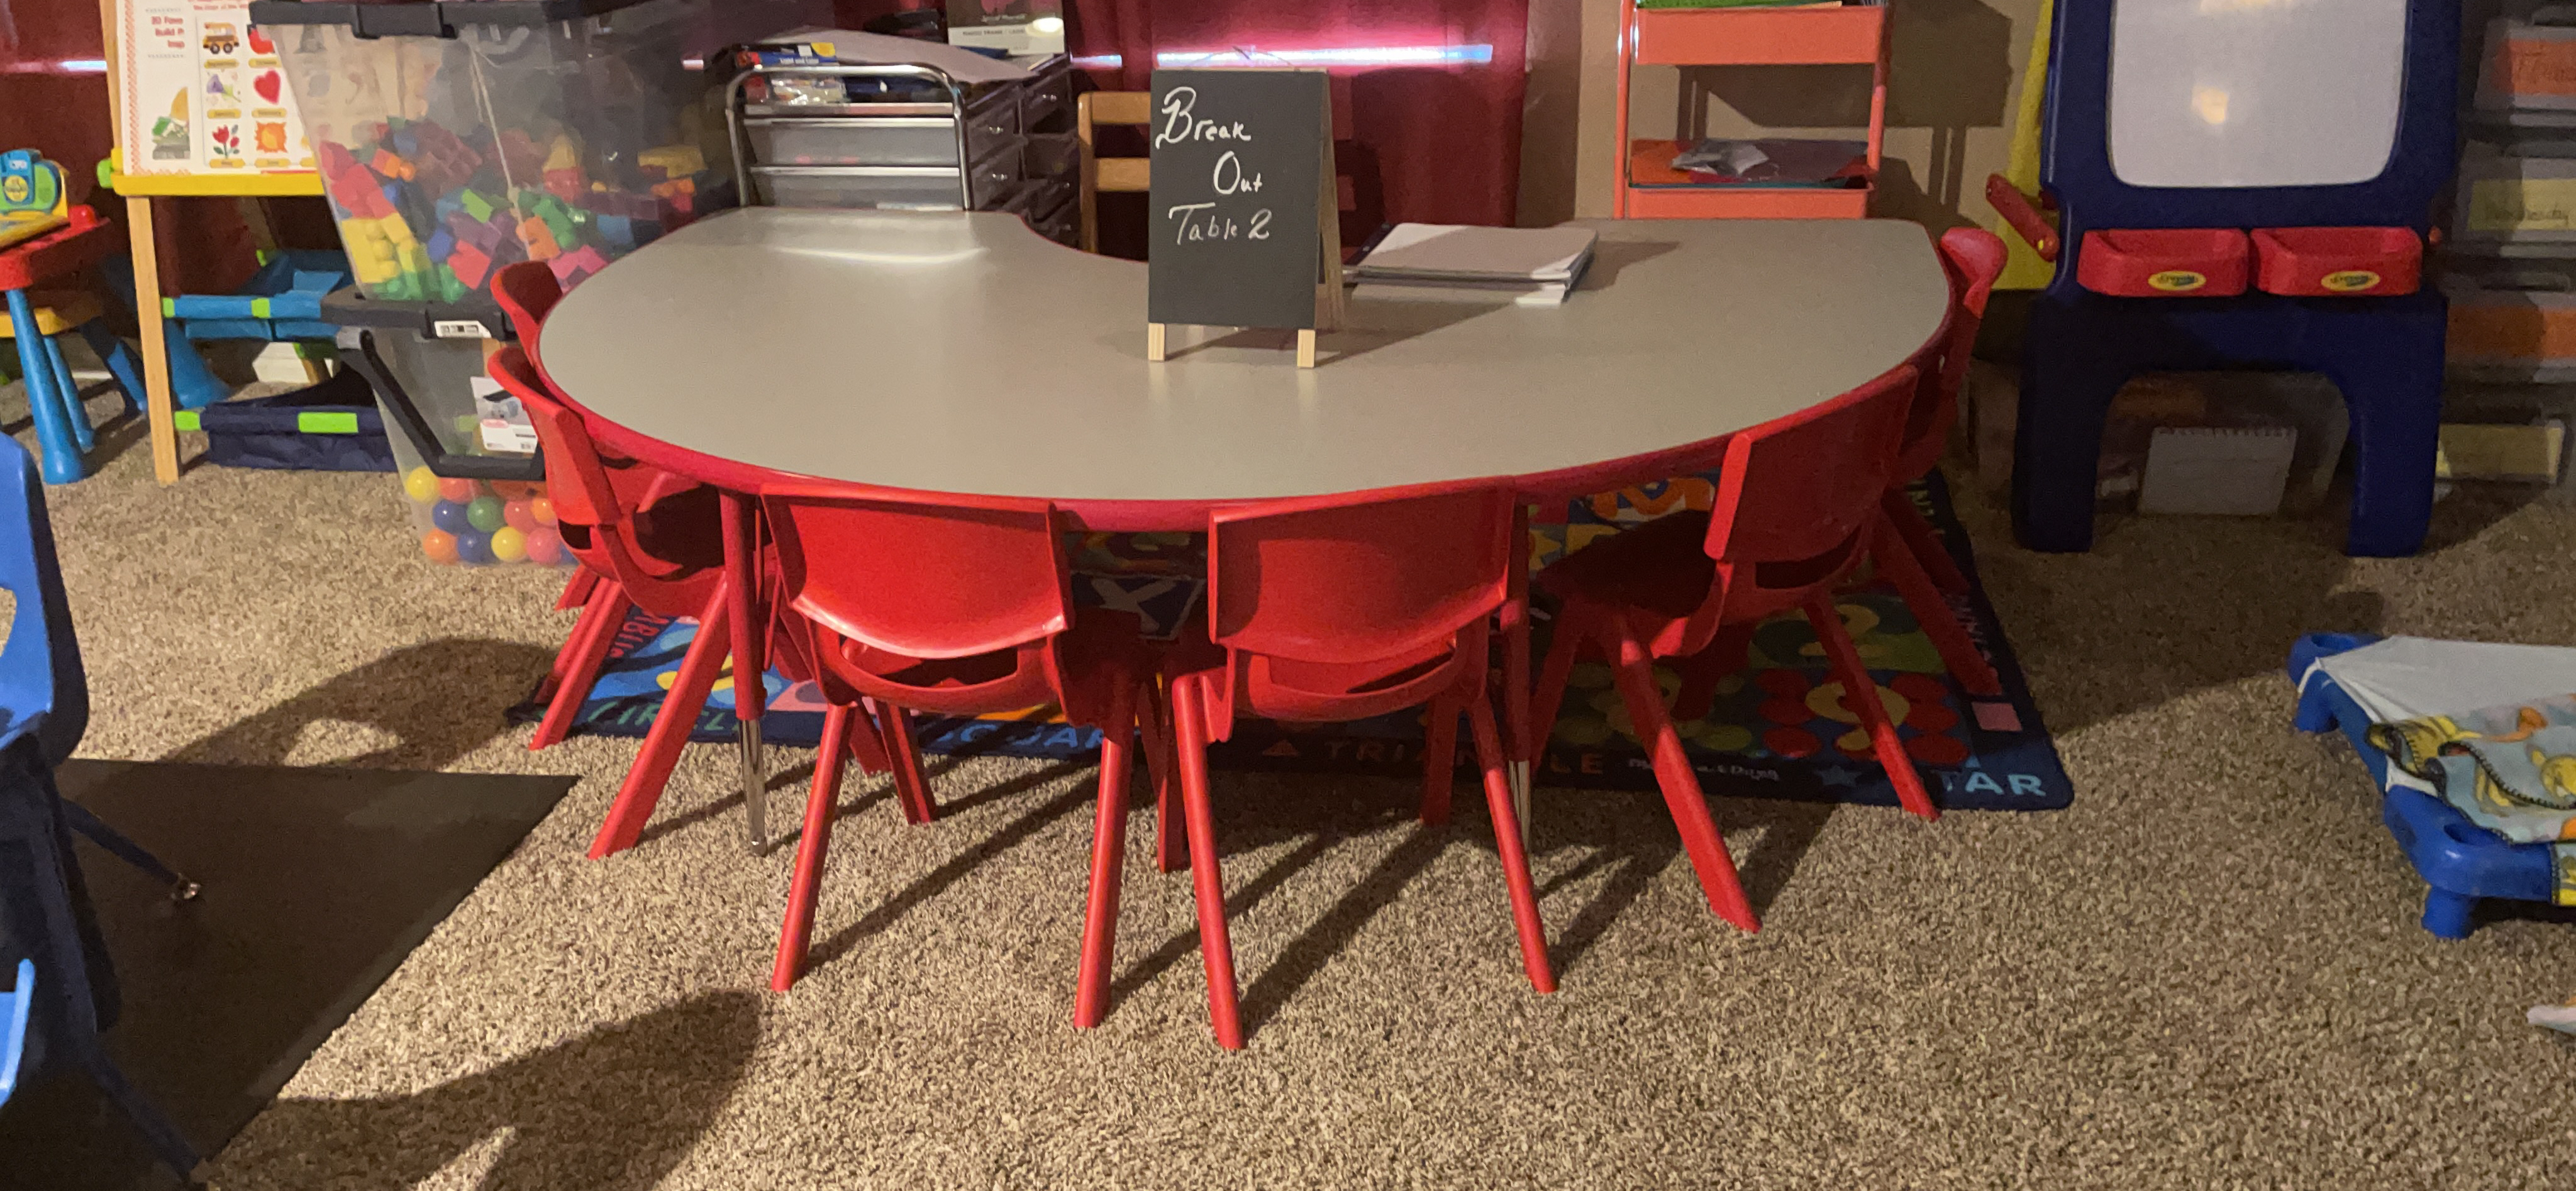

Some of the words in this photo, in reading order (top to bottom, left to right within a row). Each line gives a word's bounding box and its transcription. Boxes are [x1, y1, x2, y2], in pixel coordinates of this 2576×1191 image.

[1155, 86, 1252, 150] Break
[1213, 150, 1263, 195] Out
[1168, 202, 1238, 245] Table
[1248, 208, 1273, 240] 2
[1931, 768, 2047, 797] TAR
